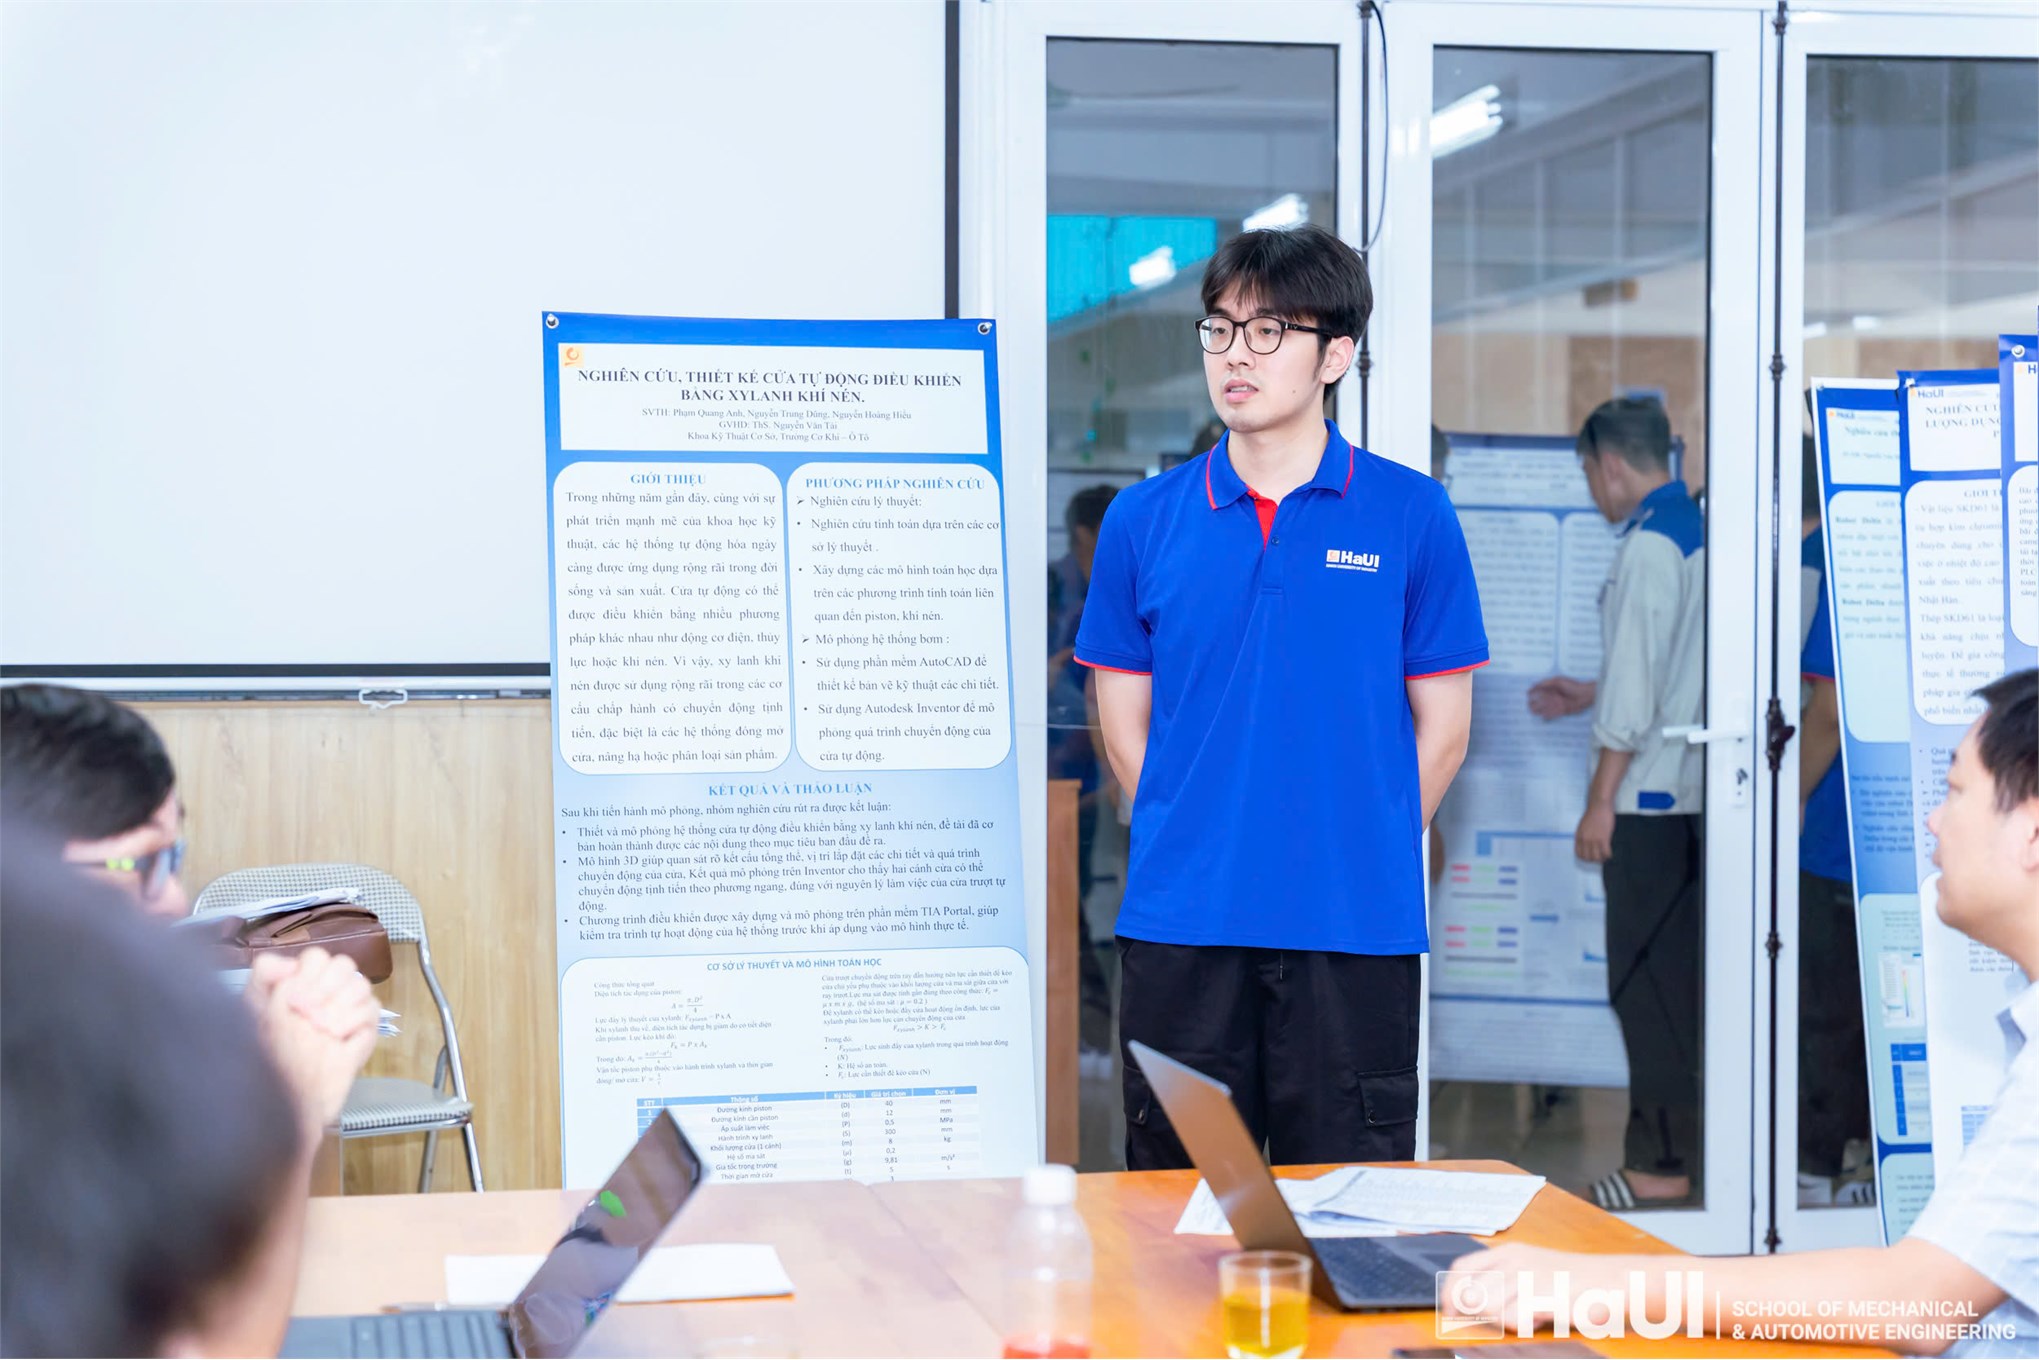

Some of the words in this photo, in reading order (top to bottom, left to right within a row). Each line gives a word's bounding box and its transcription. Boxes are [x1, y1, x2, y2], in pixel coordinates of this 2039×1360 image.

[578, 367, 639, 381] NGHIÊN
[729, 389, 792, 401] XYLANH
[798, 387, 825, 402] KHÍ
[830, 388, 865, 402] NÉN.
[1918, 390, 1944, 399] HaUI
[698, 409, 725, 419] Quang
[782, 410, 804, 420] Trung
[688, 432, 709, 440] Khoa
[630, 473, 661, 484] GIỚI
[666, 474, 706, 486] THIỆU
[805, 477, 862, 488] PHƯƠNG
[866, 476, 900, 488] PHÁP
[903, 476, 953, 489] NGHIÊN
[956, 477, 984, 489] CỨU
[565, 491, 598, 505] Trong
[601, 491, 636, 505] những
[639, 493, 662, 502] năm
[665, 489, 685, 505] gần
[687, 492, 710, 505] đây,
[713, 492, 739, 505] cùng
[742, 492, 760, 502] với
[763, 495, 776, 504] sự
[810, 495, 848, 508] Nghiên
[850, 496, 871, 506] cứu
[873, 496, 883, 508] lý
[602, 538, 620, 549] các
[625, 538, 638, 551] hệ
[643, 536, 674, 551] thống
[679, 541, 691, 551] tự
[695, 539, 722, 551] động
[727, 539, 746, 549] hóa
[751, 539, 777, 552] ngày
[1341, 551, 1380, 568] HaUI
[919, 656, 972, 666] AutoCAD
[835, 703, 862, 716] dụng
[864, 702, 913, 713] Autodesk
[917, 702, 960, 713] Inventor
[978, 702, 995, 712] mô
[578, 900, 607, 913] động.
[706, 962, 720, 971] CƠ
[736, 960, 745, 970] LÝ
[747, 959, 780, 969] THUYẾT
[781, 959, 794, 968] VÀ
[795, 958, 812, 968] MÔ
[813, 958, 836, 967] HÌNH
[837, 957, 861, 967] TOÁN
[863, 958, 881, 967] HỌC
[754, 1105, 772, 1113] piston
